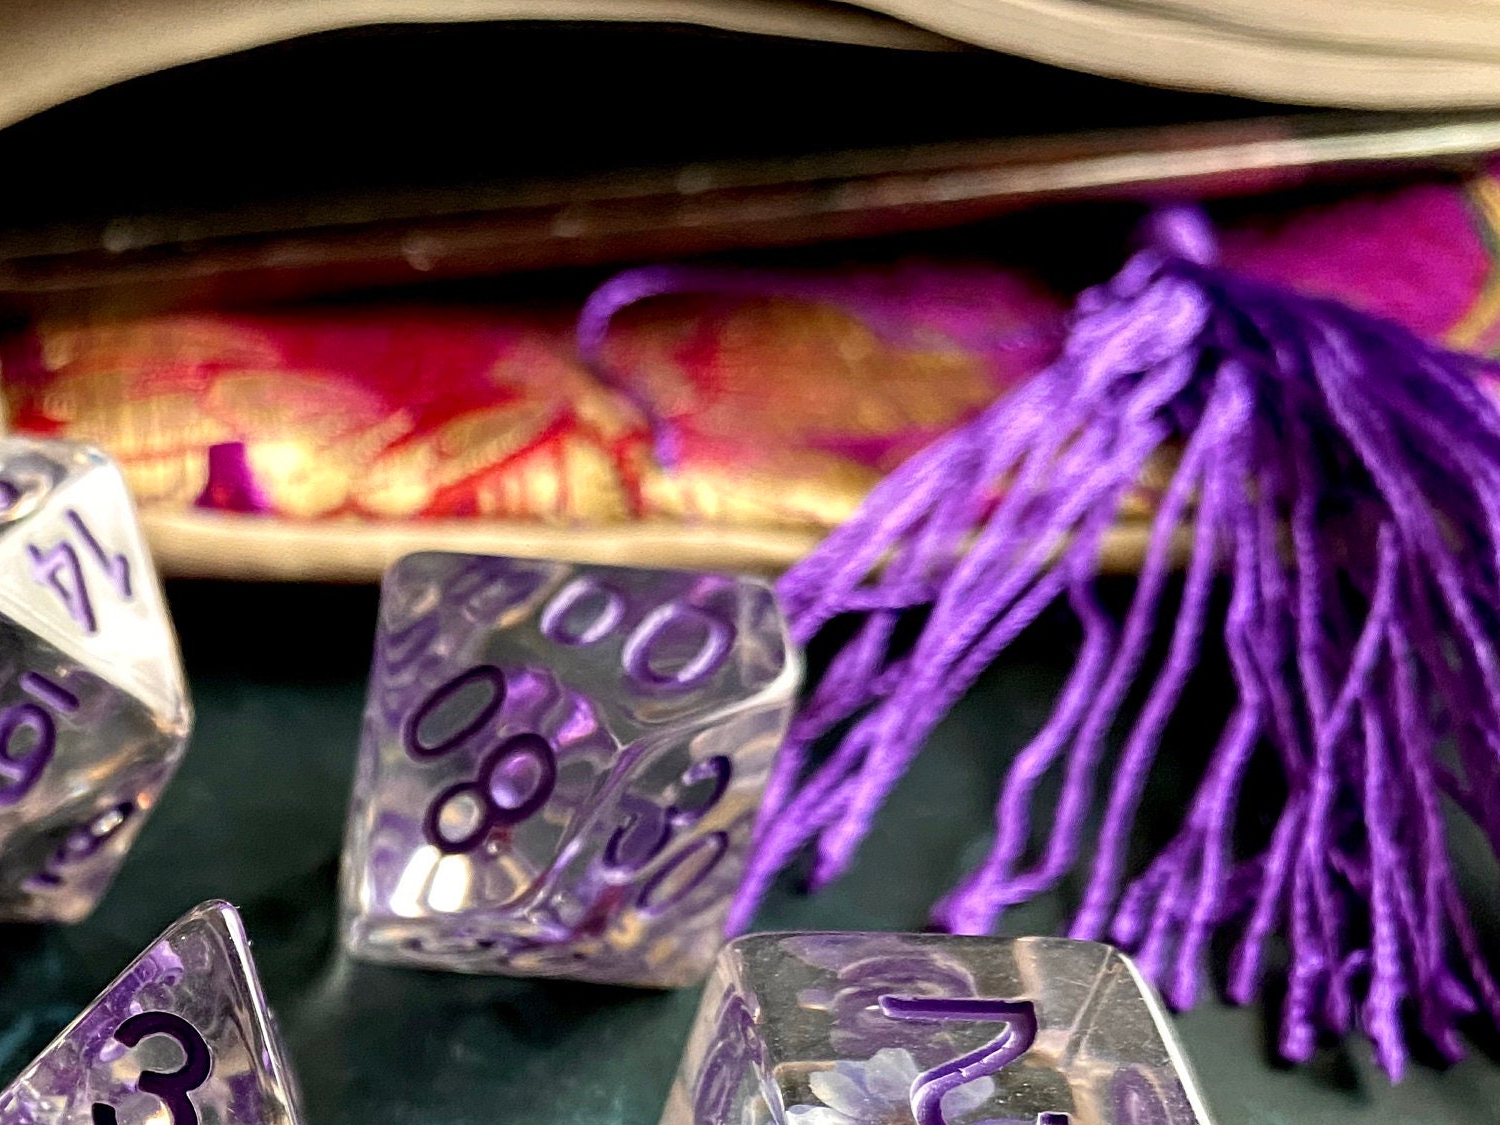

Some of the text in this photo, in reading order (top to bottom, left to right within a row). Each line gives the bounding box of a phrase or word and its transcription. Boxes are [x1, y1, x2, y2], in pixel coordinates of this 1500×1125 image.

[26, 508, 133, 634] 14
[539, 575, 738, 695] 00
[403, 664, 558, 855] 80
